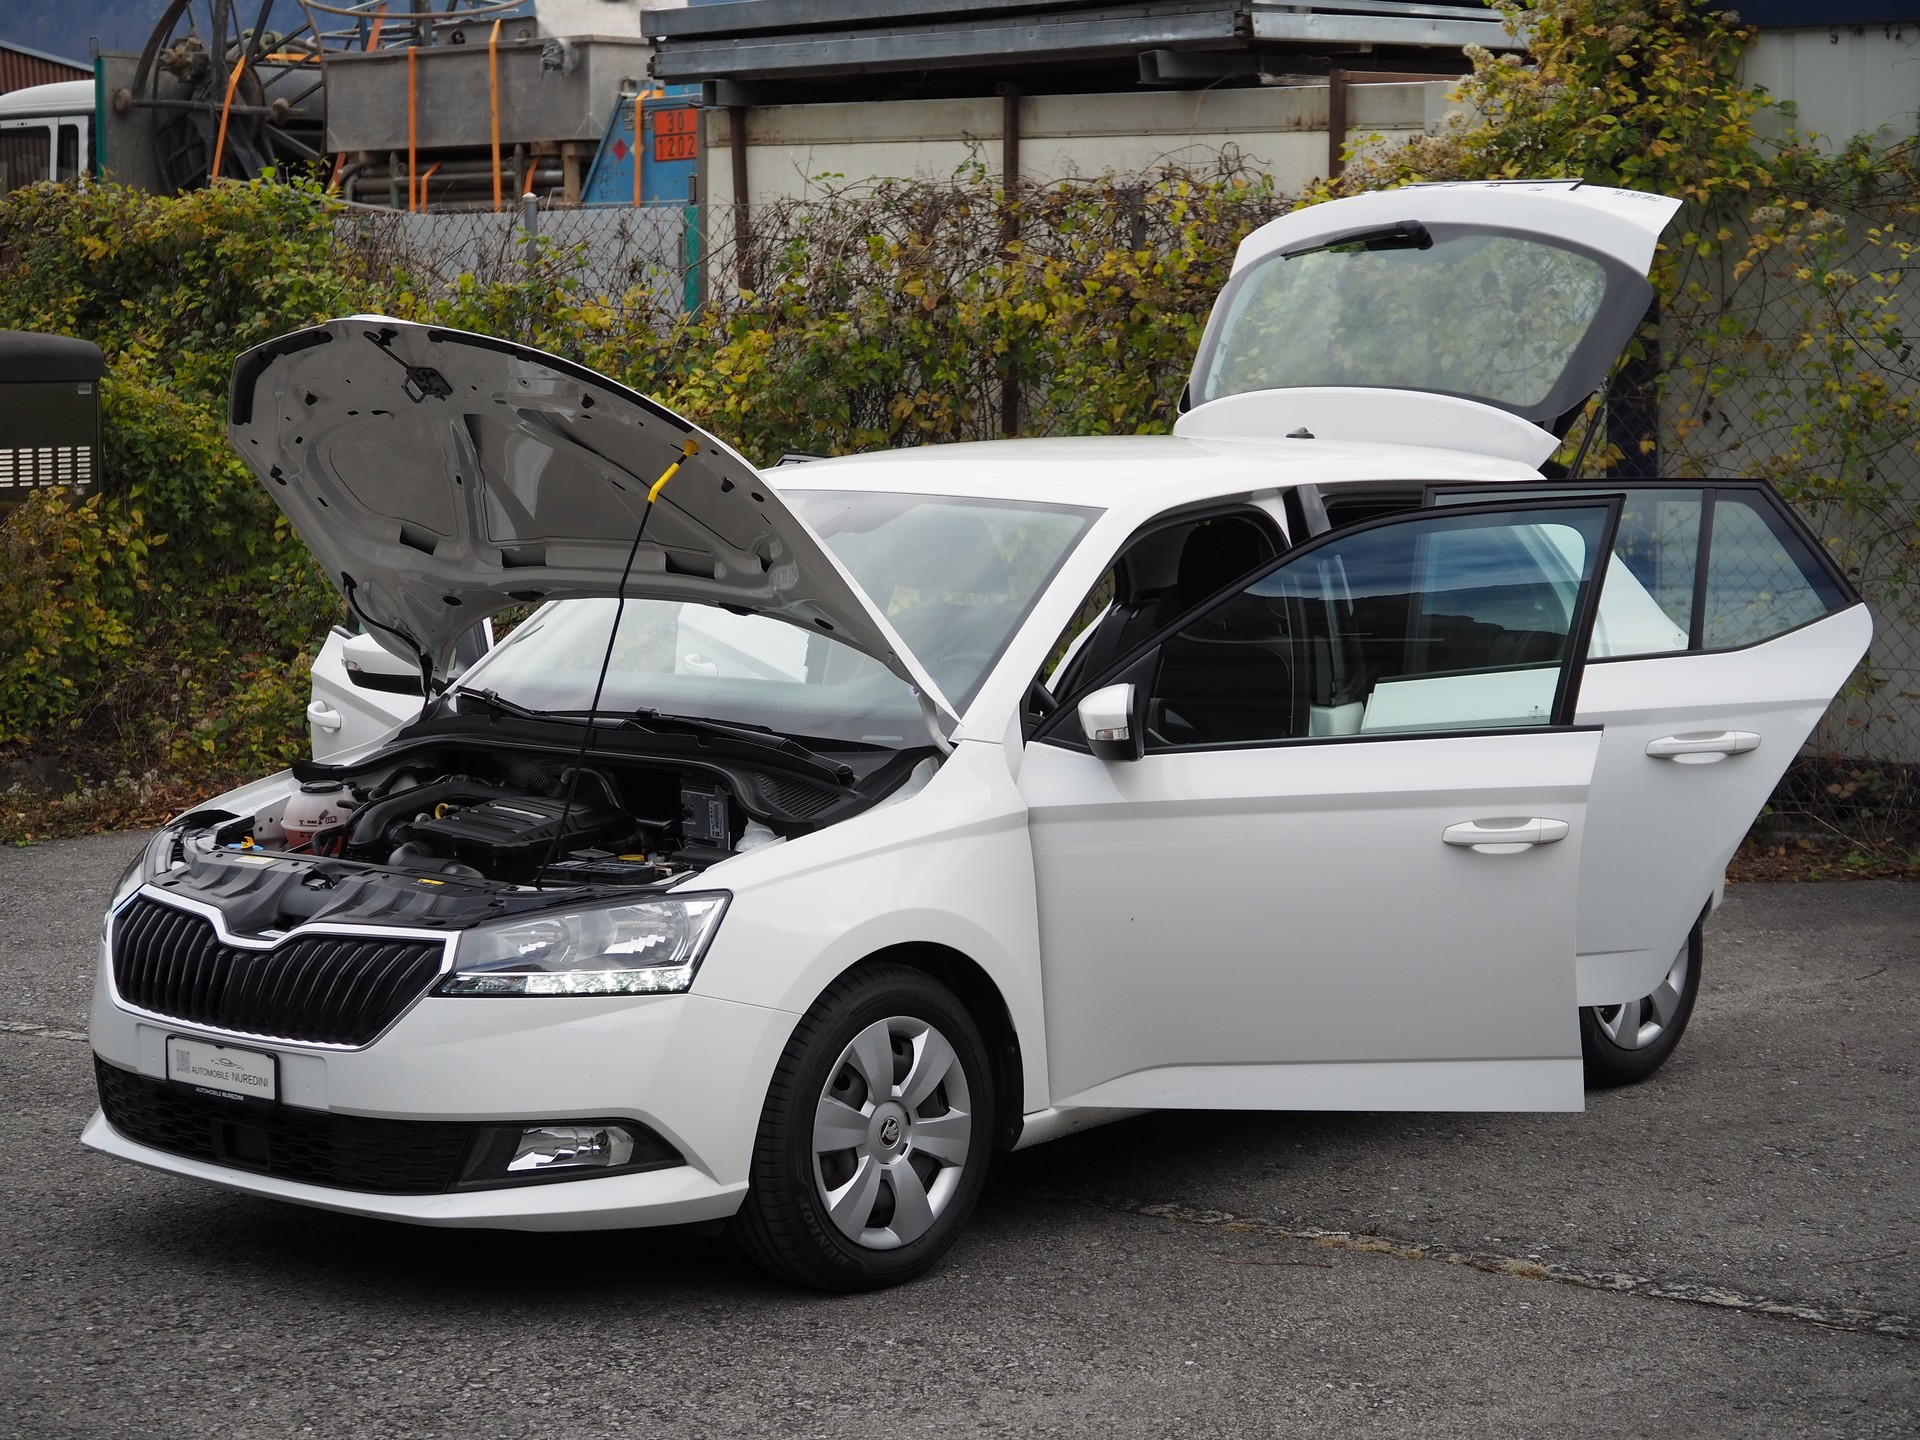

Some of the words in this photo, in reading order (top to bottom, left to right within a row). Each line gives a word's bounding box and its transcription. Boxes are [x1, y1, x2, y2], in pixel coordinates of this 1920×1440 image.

[667, 112, 685, 133] 30
[658, 136, 695, 158] 1202
[191, 1066, 229, 1081] AUTOMOBILE
[232, 1072, 269, 1088] NUREDINI
[195, 1087, 221, 1097] AUTOMOBILE
[221, 1092, 244, 1101] NUREDINI
